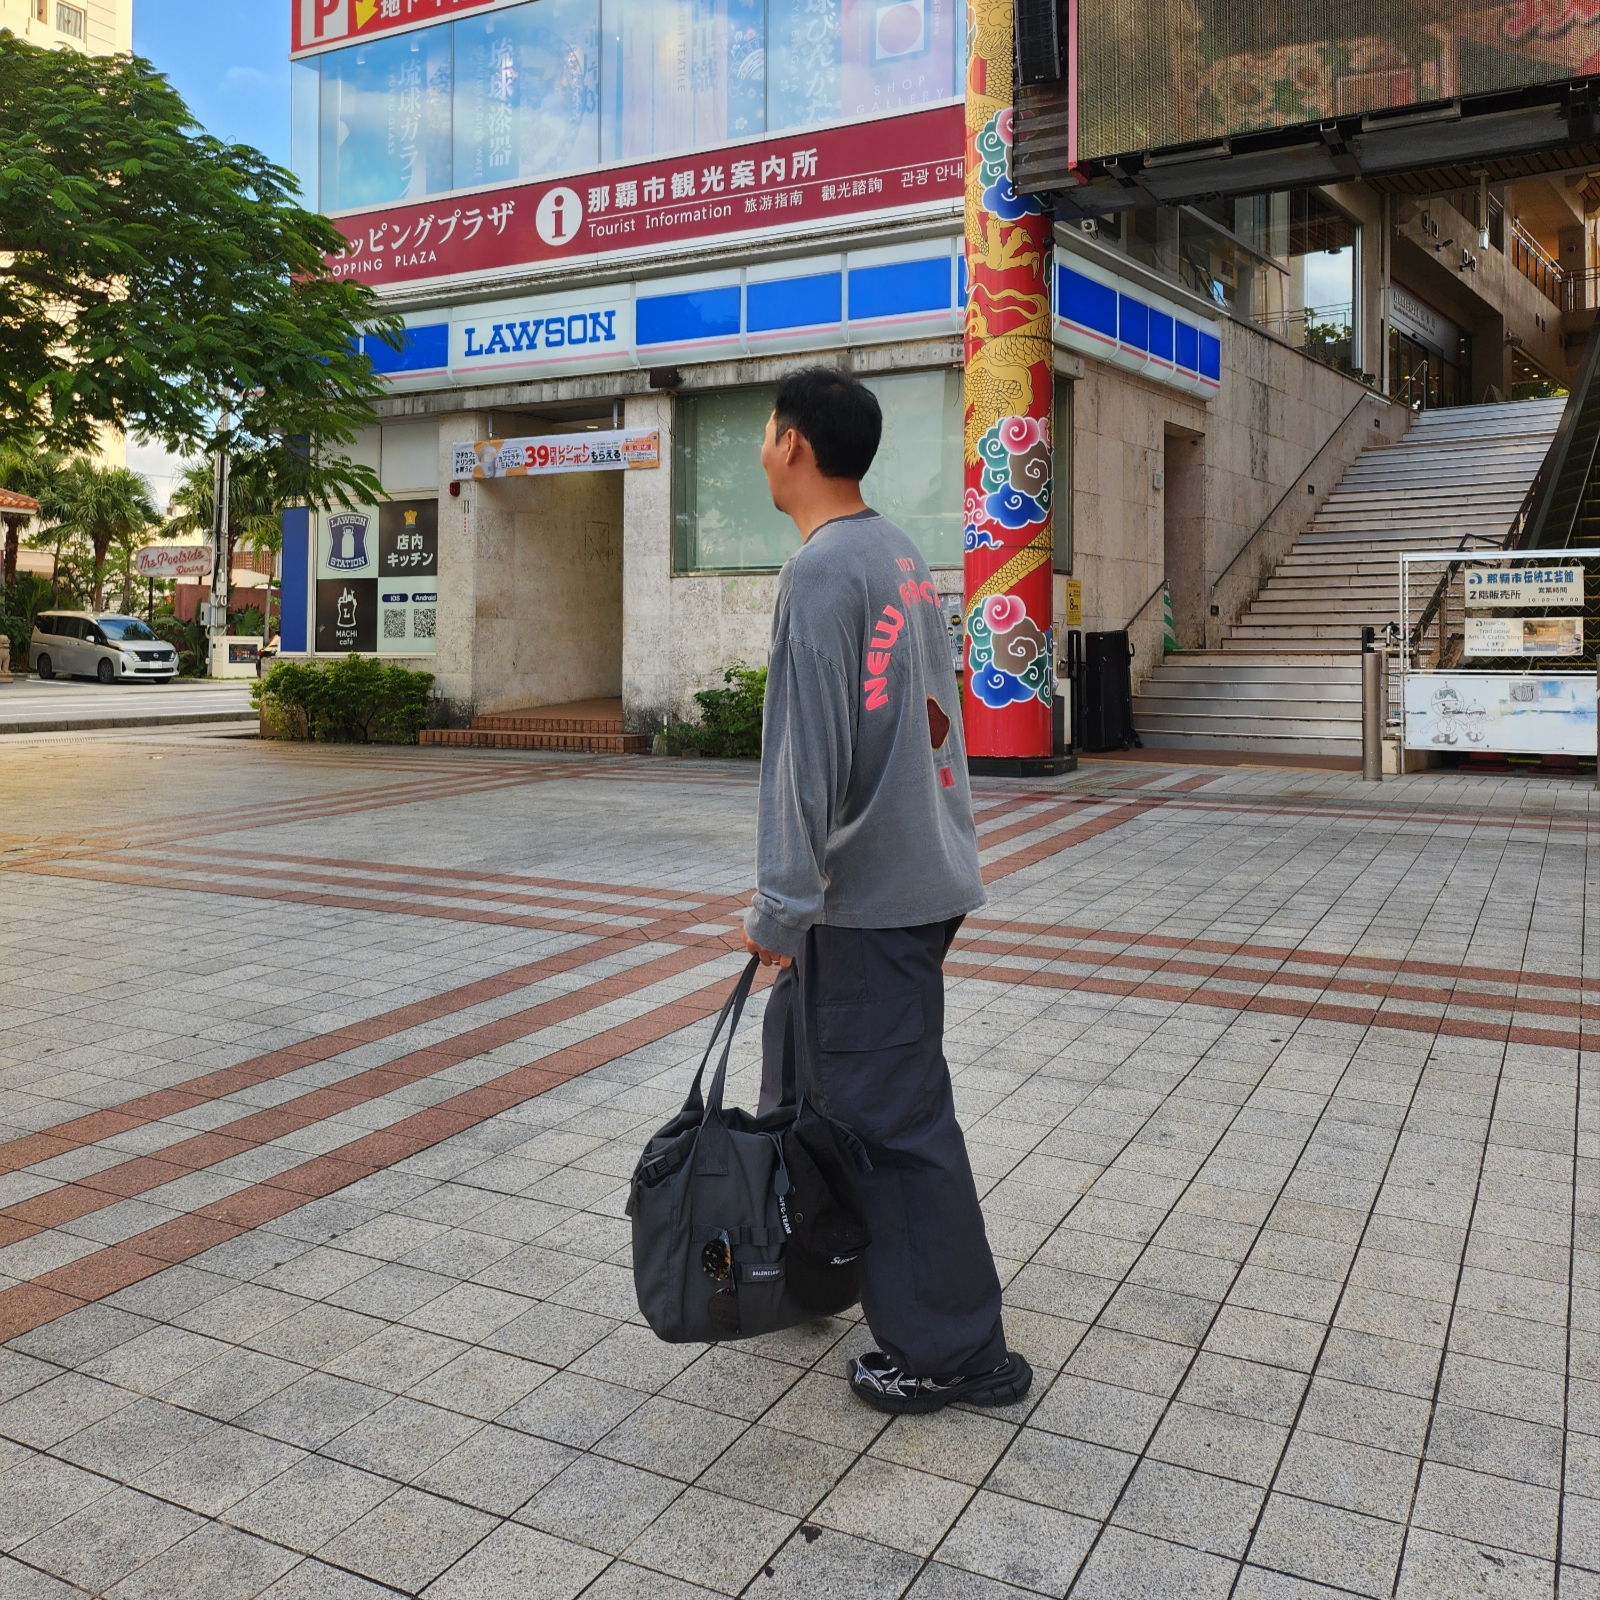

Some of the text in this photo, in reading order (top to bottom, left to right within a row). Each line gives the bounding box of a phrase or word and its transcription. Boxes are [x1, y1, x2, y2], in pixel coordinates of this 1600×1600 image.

[677, 41, 686, 92] TEXTILE
[790, 29, 800, 93] BINGATA
[874, 76, 925, 97] SHOP
[487, 37, 516, 168] 琉球漆器
[856, 88, 944, 115] GALLERY
[387, 117, 396, 155] GLASS
[474, 146, 484, 179] WARE
[587, 148, 819, 213] 那覇市観光案内所
[900, 162, 964, 188] 관광 안내
[821, 177, 883, 202] 觀光諮詢
[744, 190, 804, 213] 旅游指南
[588, 203, 732, 238] Tourist Information
[395, 250, 437, 267] PLAZA
[464, 309, 616, 357] LAWSON
[524, 444, 550, 468] 39
[558, 442, 590, 455] レシート
[558, 453, 591, 466] クーポン
[591, 449, 621, 461] もらえる
[330, 514, 367, 528] LAWSON
[396, 533, 424, 551] 店内
[140, 547, 205, 570] The Poolside
[329, 556, 366, 569] STATION
[387, 552, 434, 568] キッチン
[1486, 570, 1574, 585] 那覇市伝統工芸館
[415, 593, 437, 601] Android
[1469, 589, 1522, 600] 2階販売所
[335, 629, 358, 638] MACHI
[339, 637, 354, 646] café
[863, 605, 905, 711] NEW
